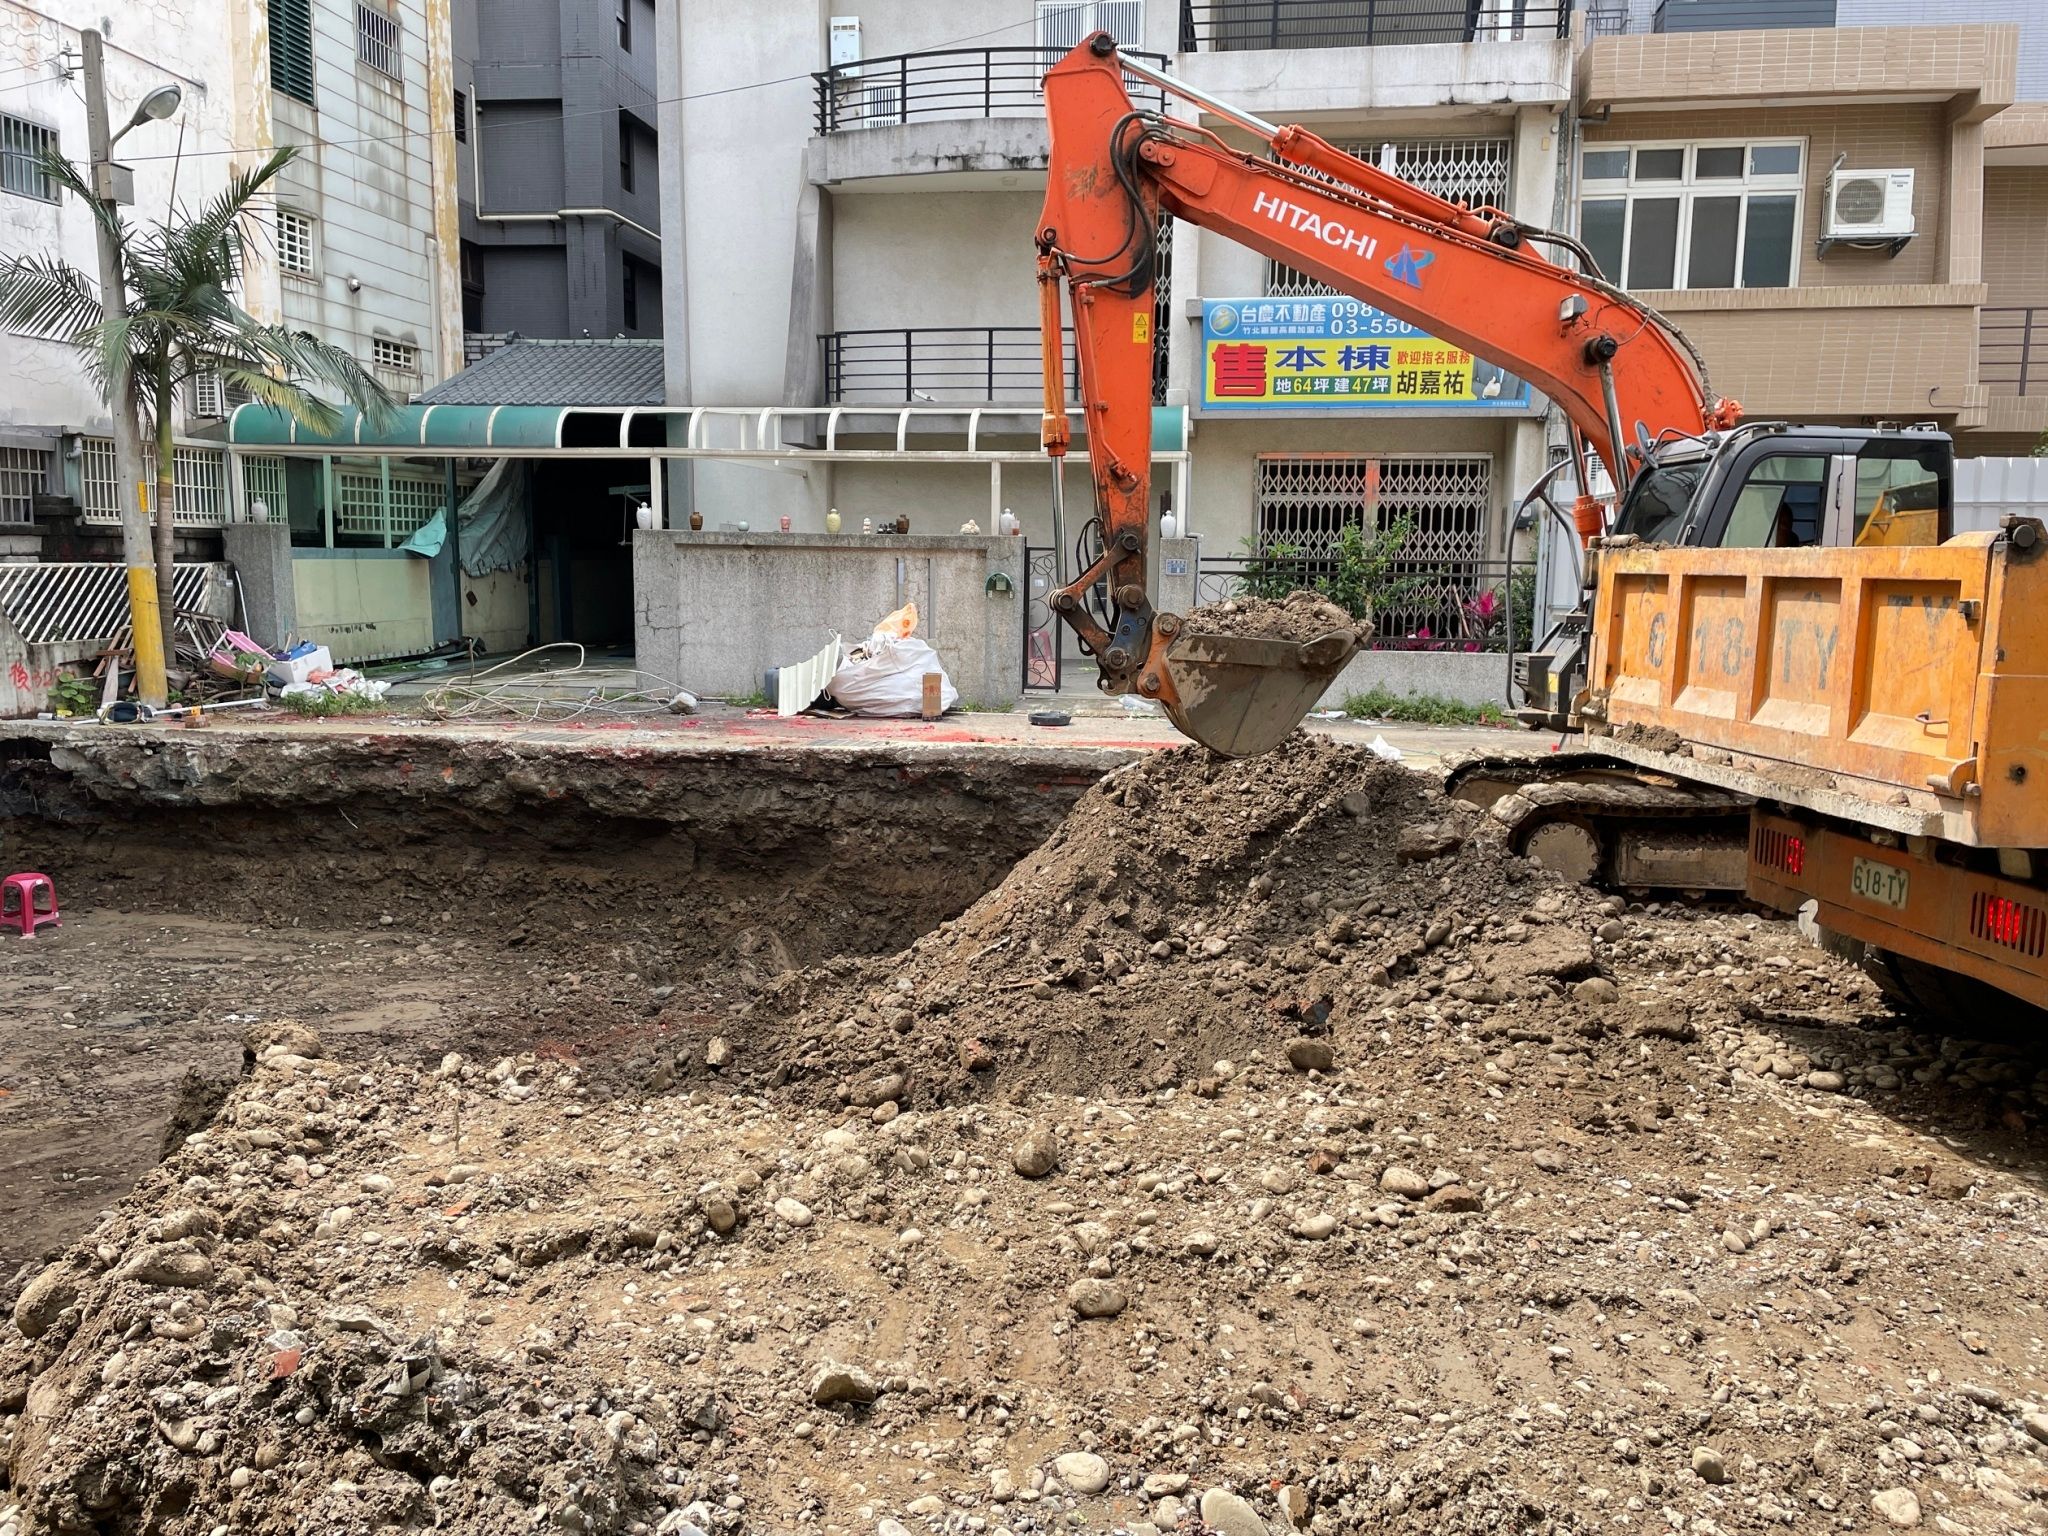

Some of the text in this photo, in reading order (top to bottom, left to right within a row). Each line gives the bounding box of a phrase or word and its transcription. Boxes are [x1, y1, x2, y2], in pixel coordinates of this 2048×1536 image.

[1252, 191, 1378, 260] HITACHI
[1241, 303, 1326, 323] 台慶不動產
[1212, 343, 1267, 396] 售
[1274, 345, 1391, 372] 本棟
[1397, 351, 1471, 365] 歡迎指名服務
[1275, 377, 1388, 393] 地64坪 建47坪
[1397, 370, 1465, 395] 胡嘉祐
